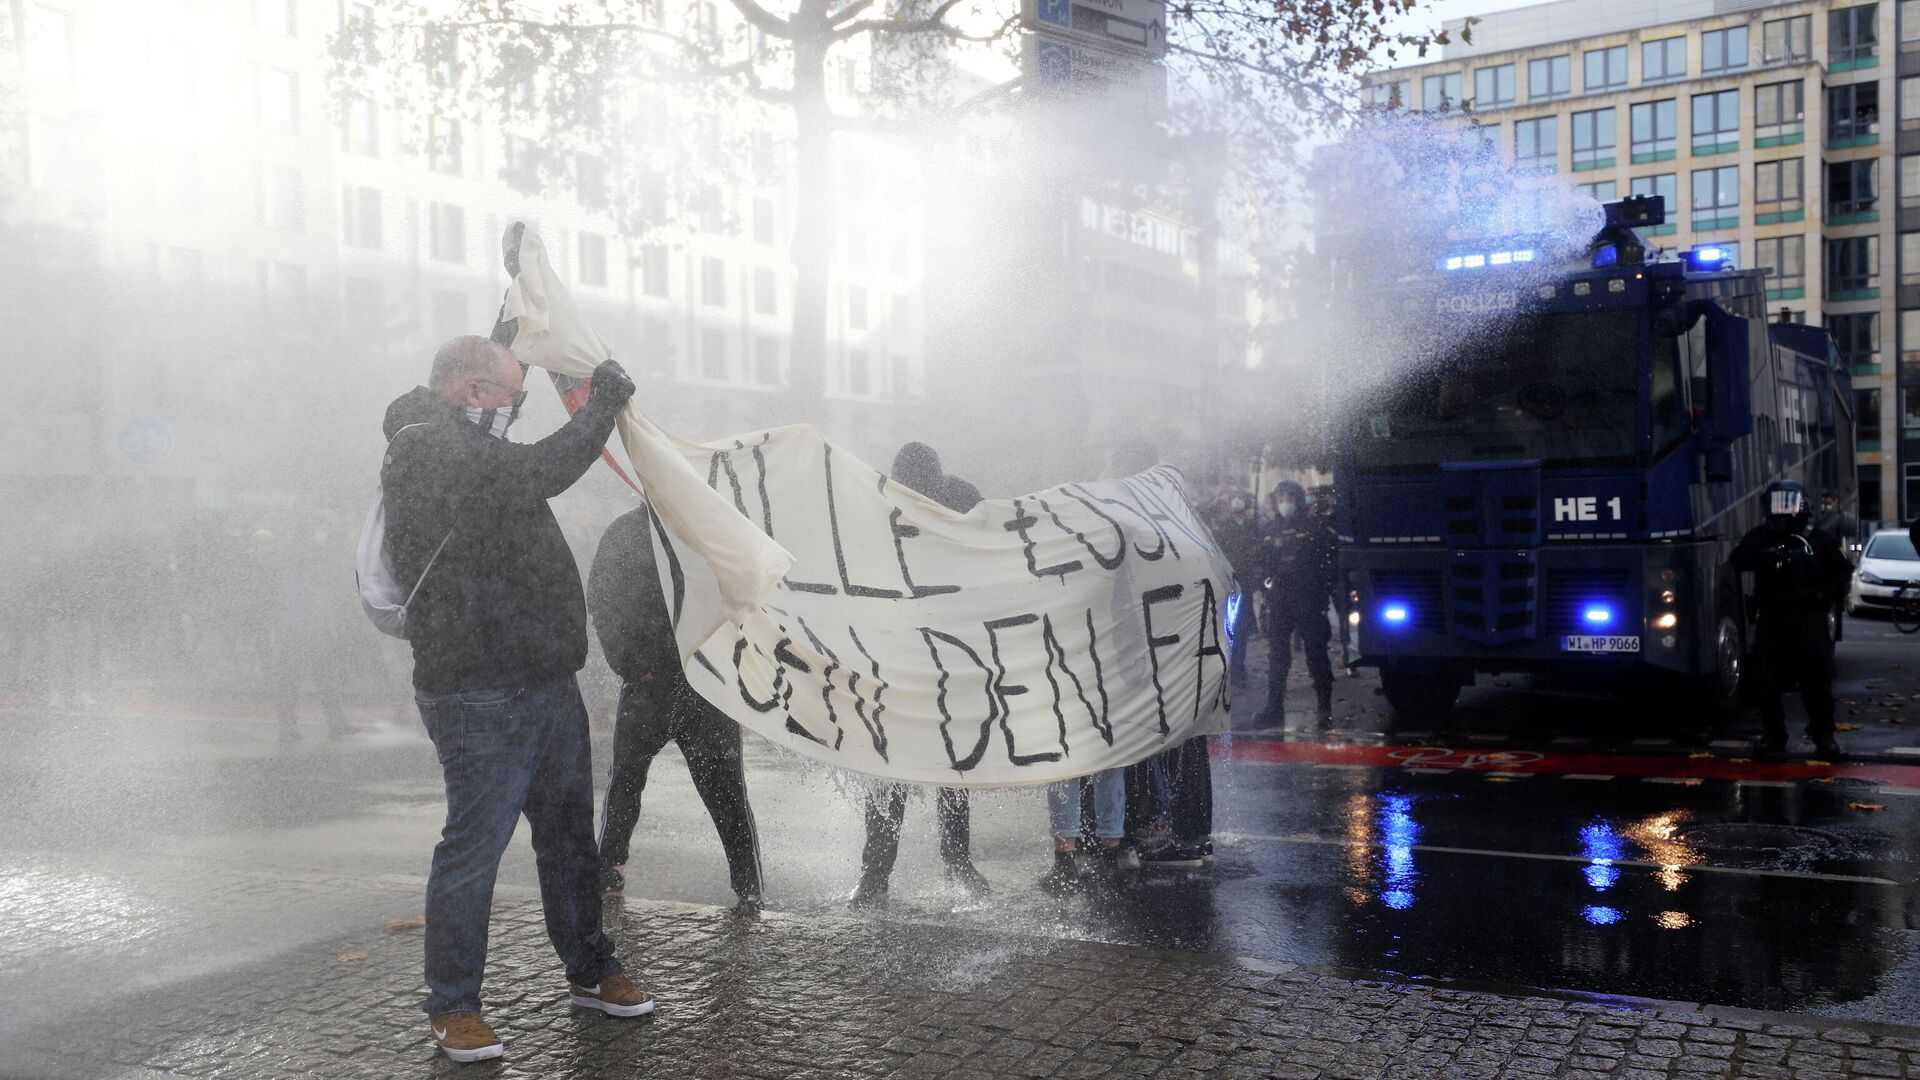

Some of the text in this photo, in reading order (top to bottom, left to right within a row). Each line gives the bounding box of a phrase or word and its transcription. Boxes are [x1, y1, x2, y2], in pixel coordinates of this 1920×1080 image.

[1436, 290, 1517, 314] POLIZEI
[1554, 497, 1622, 522] HE 1
[1568, 637, 1639, 650] WI HP 9066
[915, 608, 1115, 778] DEN
[1142, 577, 1232, 737] FA
